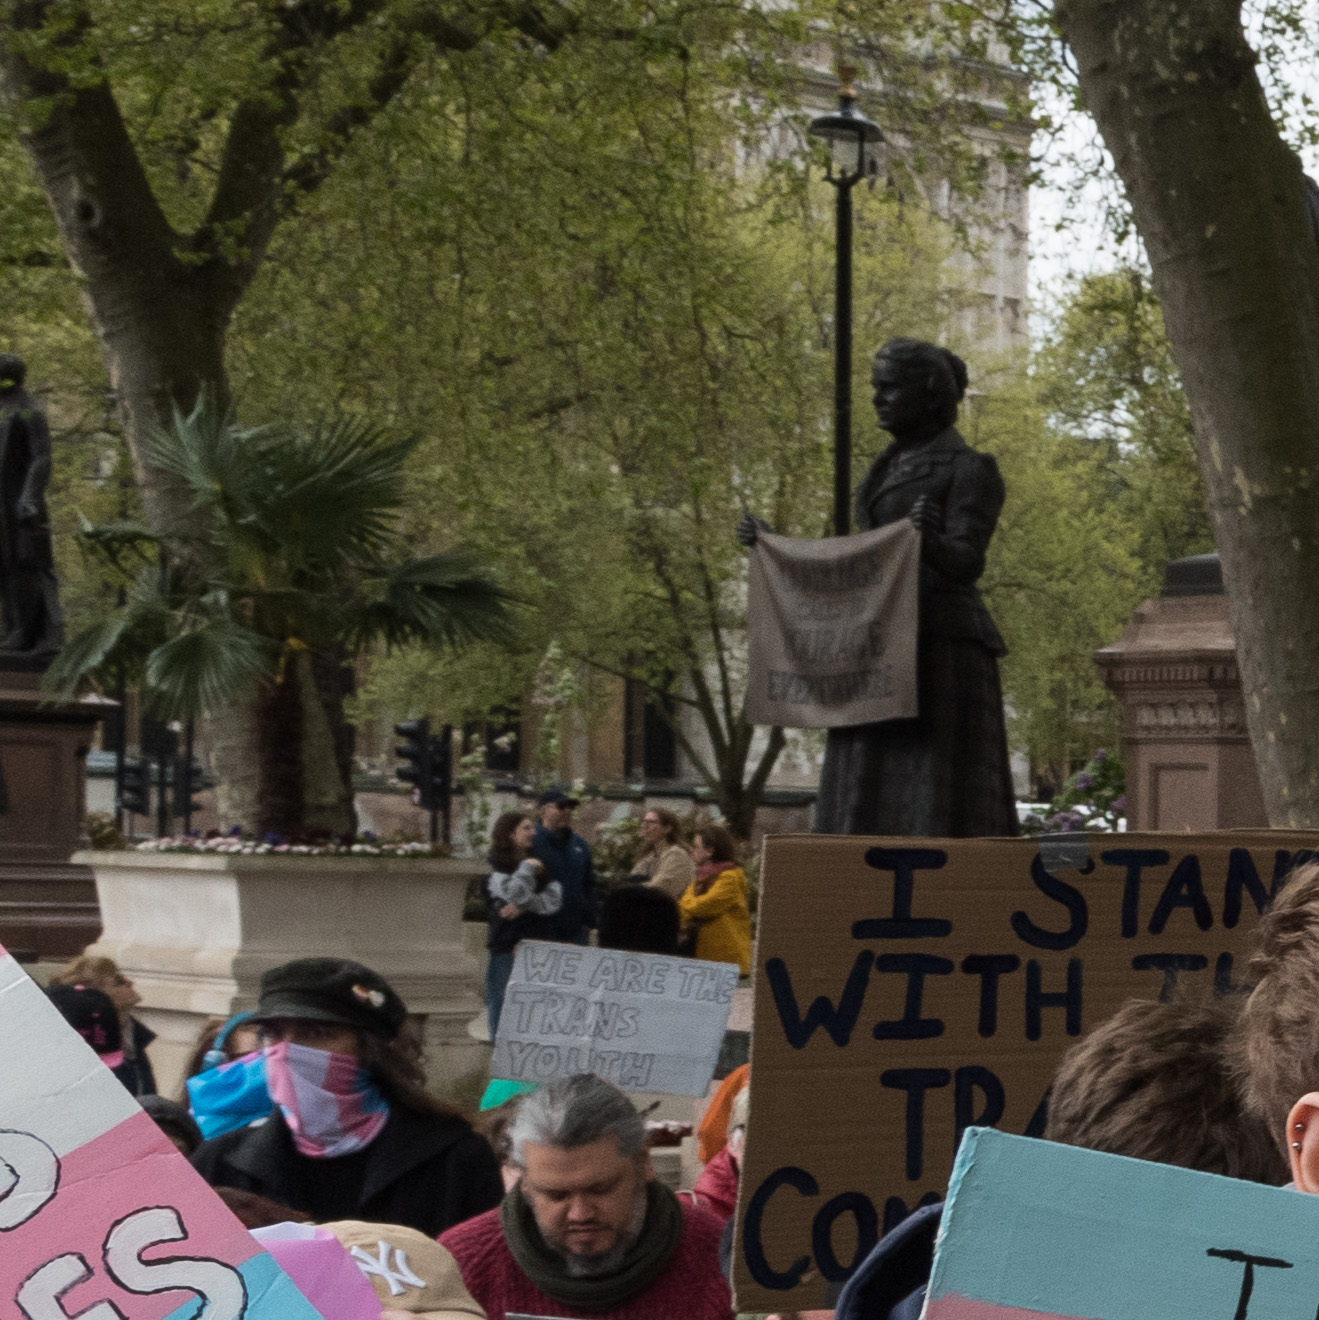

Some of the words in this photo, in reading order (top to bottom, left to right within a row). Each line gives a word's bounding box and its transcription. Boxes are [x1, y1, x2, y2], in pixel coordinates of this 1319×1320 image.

[851, 846, 954, 941] I
[523, 949, 583, 986] WE
[588, 956, 670, 994] ARE
[678, 963, 740, 1005] THE
[764, 949, 1084, 1050] WITH
[511, 990, 641, 1041] TRANS
[506, 1040, 656, 1088] YOUTH
